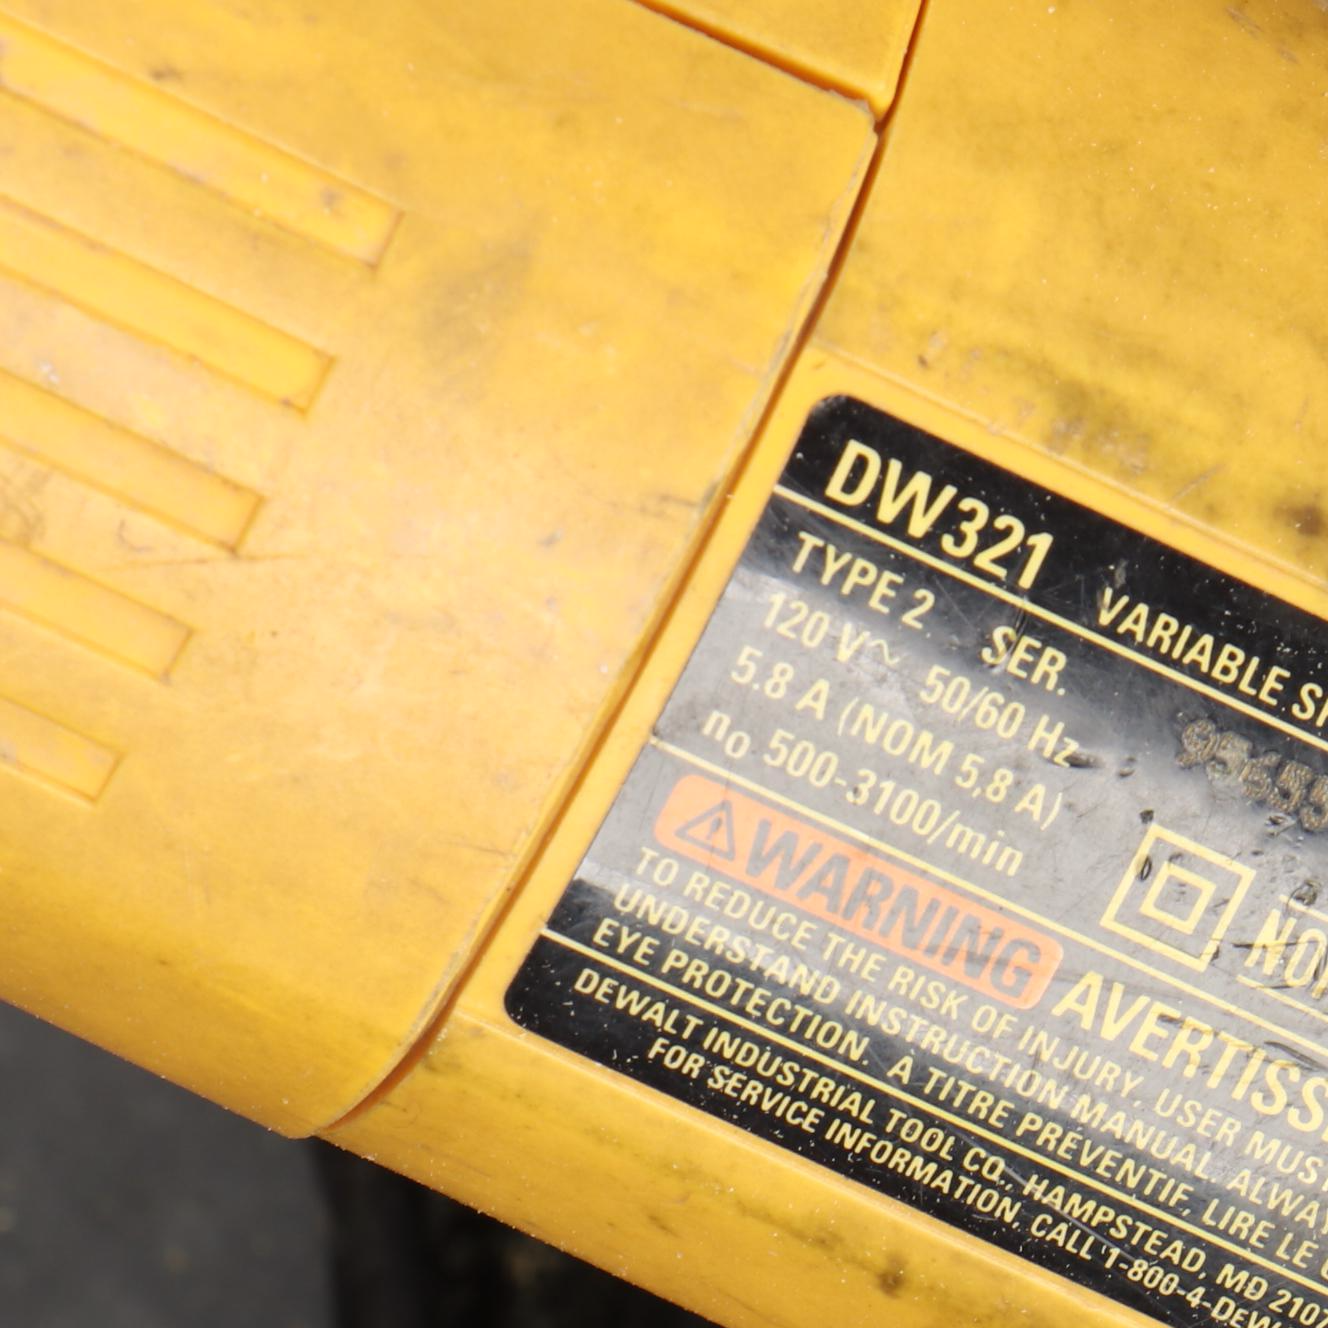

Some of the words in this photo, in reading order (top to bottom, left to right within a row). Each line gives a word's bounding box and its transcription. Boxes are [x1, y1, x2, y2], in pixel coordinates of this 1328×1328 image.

[786, 533, 901, 612] TYPE
[901, 586, 936, 629] 2
[822, 441, 1054, 592] DW321
[760, 591, 830, 648] 120
[917, 663, 1026, 743] 50/60
[1026, 715, 1083, 767] Hz
[978, 622, 1078, 697] SER.
[1090, 588, 1288, 706] VARIABLE
[732, 647, 793, 699] 5.8
[795, 674, 837, 720] A
[834, 694, 954, 780] (NOM
[952, 751, 1015, 808] 5,8
[1012, 777, 1065, 832] A)
[762, 729, 1026, 877] 500-3100/min
[632, 849, 680, 885] TO
[682, 872, 815, 948] REDUCE
[818, 935, 885, 980] THE
[887, 967, 966, 1018] RISK
[970, 1005, 1016, 1041] OF
[1017, 1027, 1149, 1103] INJURY,
[1152, 1089, 1240, 1145] USER
[740, 820, 1041, 999] WARNING
[592, 918, 659, 963] EYE
[660, 950, 876, 1064] PROTECTION.
[919, 1069, 1014, 1127] TITRE
[1201, 1199, 1274, 1247] LIRE
[1275, 1234, 1318, 1267] LE
[612, 884, 842, 1004] UNDERSTAND
[844, 991, 1069, 1109] INSTRUCTION
[1069, 1095, 1225, 1181] MANUAL.
[573, 968, 703, 1040] DEWALT
[703, 1028, 881, 1123] INDUSTRIAL
[882, 1110, 960, 1159] TOOL
[961, 1147, 1021, 1187] CO.,
[1021, 1174, 1213, 1276] HAMPSTEAD,
[1214, 1263, 1269, 1302] MD
[646, 1038, 705, 1077] FOR
[706, 1065, 824, 1132] SERVICE
[823, 1119, 1028, 1226] INFORMATION,
[1029, 1213, 1099, 1258] CALL
